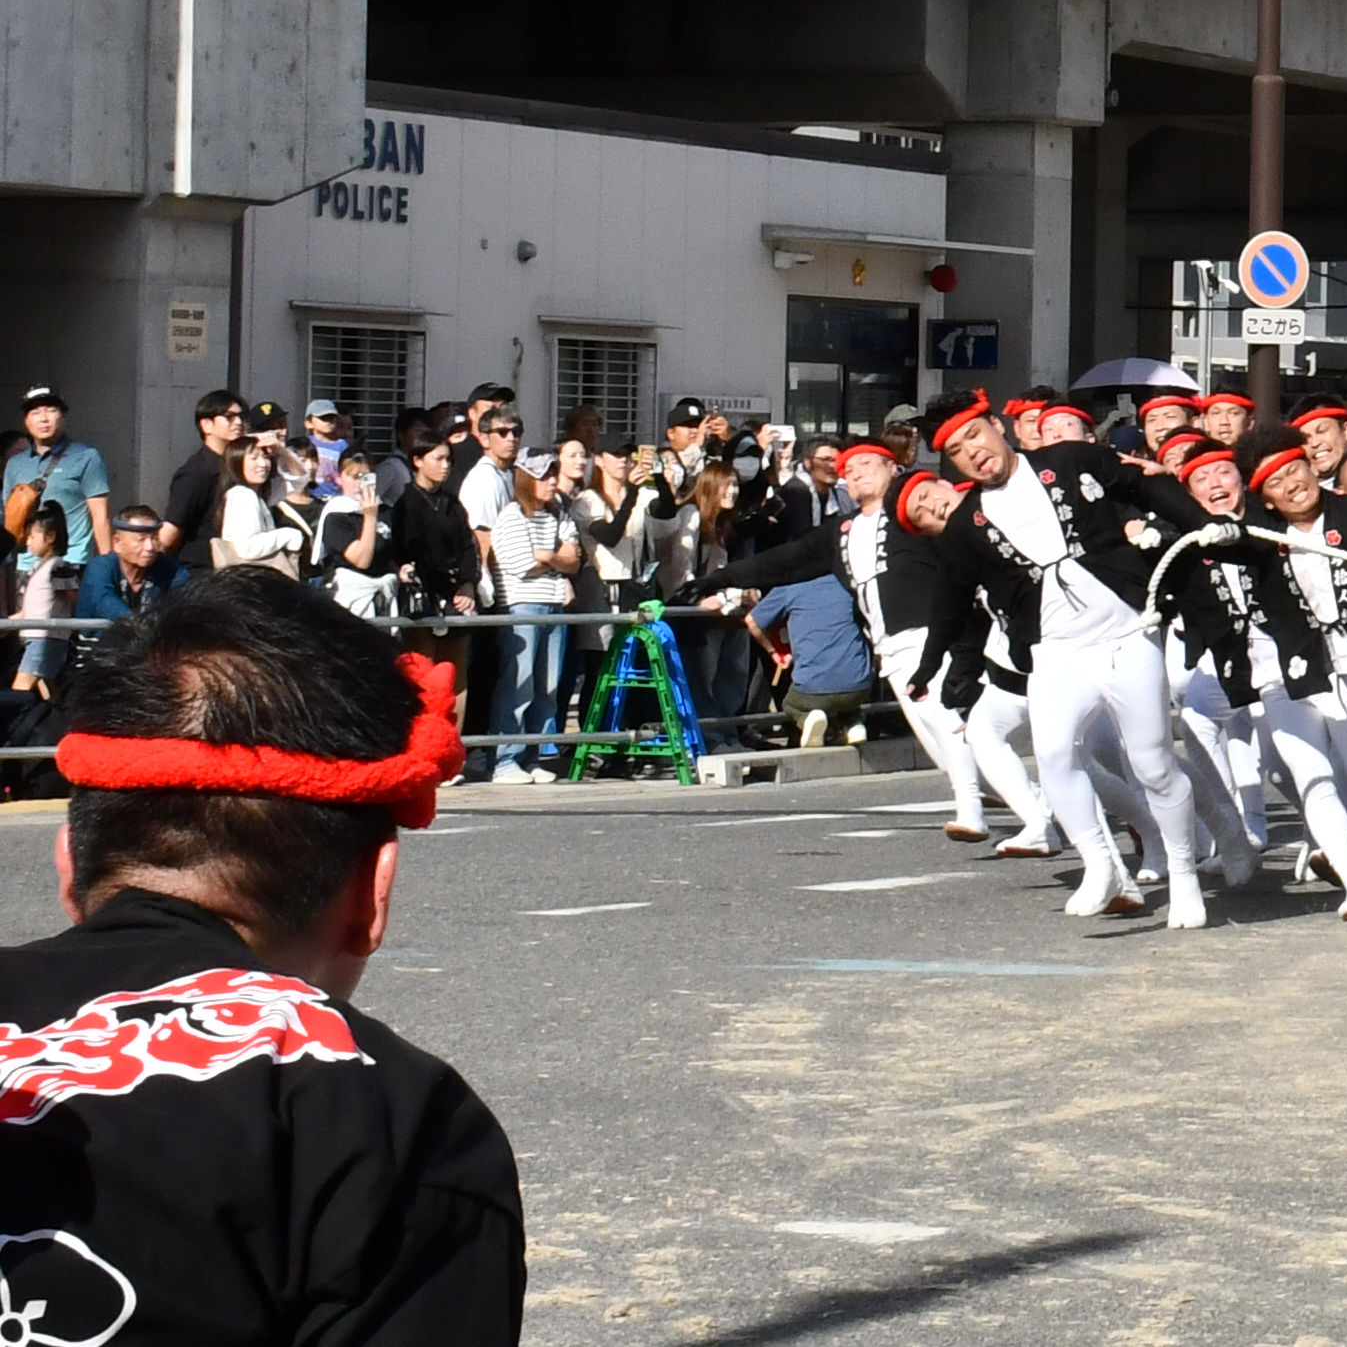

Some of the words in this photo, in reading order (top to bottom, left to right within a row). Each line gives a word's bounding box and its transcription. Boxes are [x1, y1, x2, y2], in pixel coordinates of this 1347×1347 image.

[316, 181, 409, 224] POLICE
[1246, 317, 1302, 336] ここから
